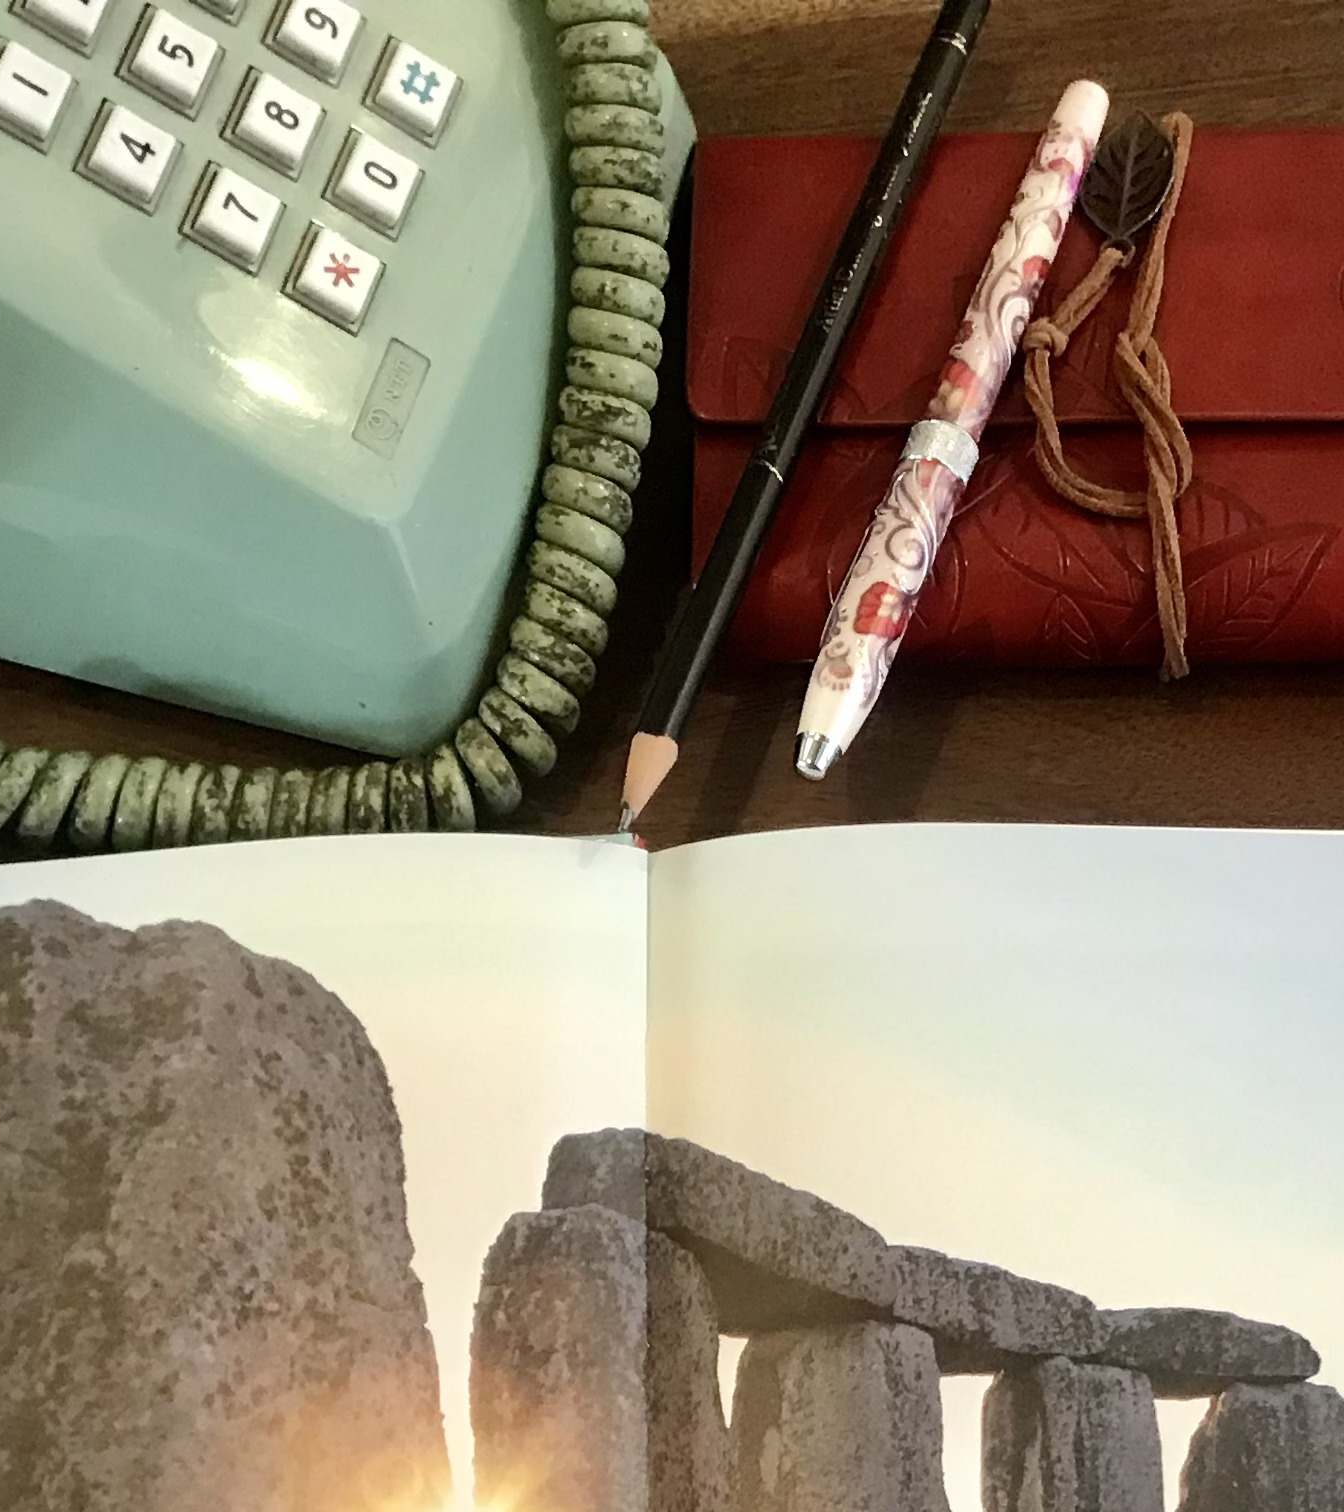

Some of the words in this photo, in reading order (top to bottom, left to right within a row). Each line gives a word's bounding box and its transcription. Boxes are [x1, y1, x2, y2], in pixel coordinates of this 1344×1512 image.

[305, 7, 339, 39] 9
[159, 35, 194, 68] 5
[265, 101, 299, 130] 8
[120, 133, 157, 163] 4
[363, 160, 398, 190] 0
[223, 192, 258, 222] 7
